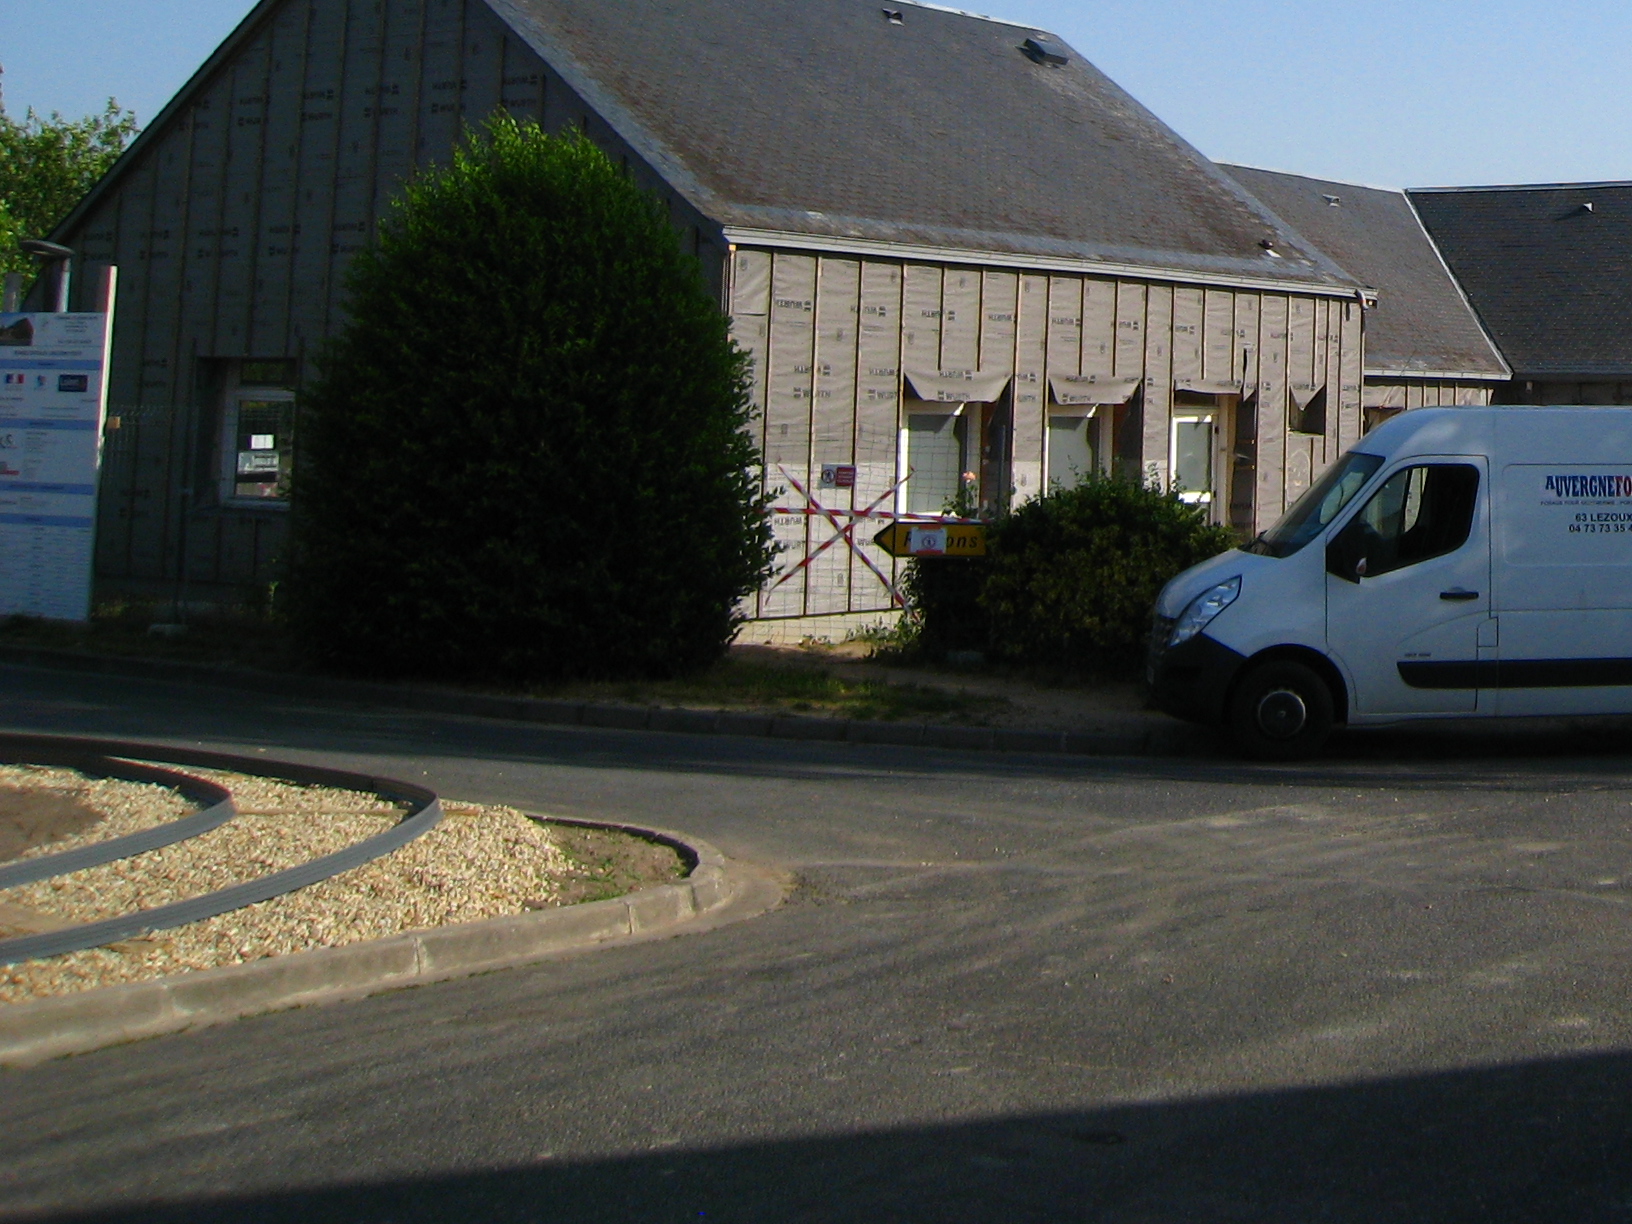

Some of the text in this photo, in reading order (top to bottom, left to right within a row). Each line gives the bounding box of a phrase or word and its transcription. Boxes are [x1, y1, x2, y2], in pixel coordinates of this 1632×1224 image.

[1575, 513, 1632, 522] 63 LEZOUX
[1568, 524, 1581, 532] 04
[1584, 524, 1596, 532] 73
[1599, 524, 1611, 532] 73
[1614, 524, 1626, 532] 35
